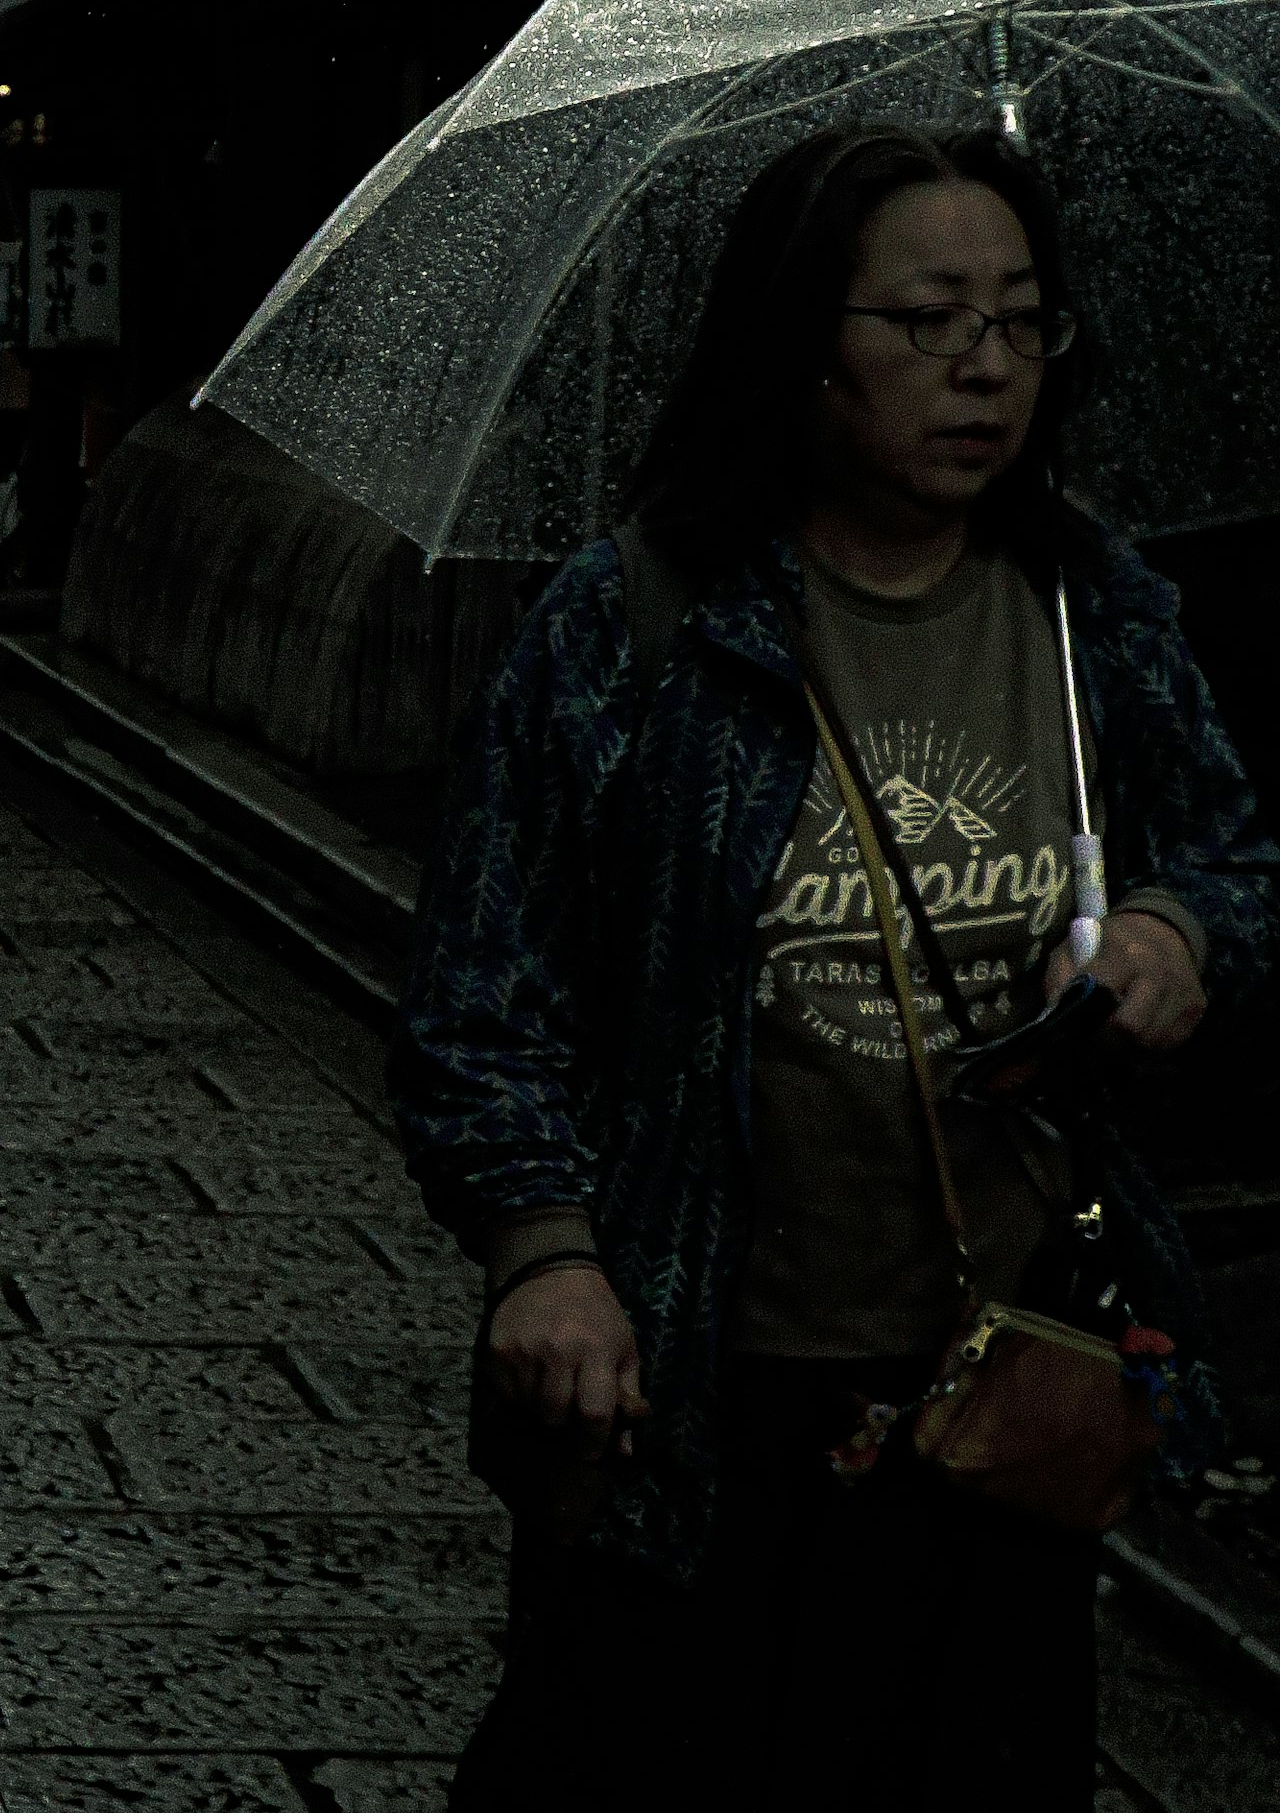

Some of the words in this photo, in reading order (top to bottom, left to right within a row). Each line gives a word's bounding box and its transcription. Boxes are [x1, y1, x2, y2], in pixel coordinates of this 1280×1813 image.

[789, 960, 883, 985] TARAS
[857, 994, 945, 1015] WISOM
[800, 1003, 847, 1046] THE
